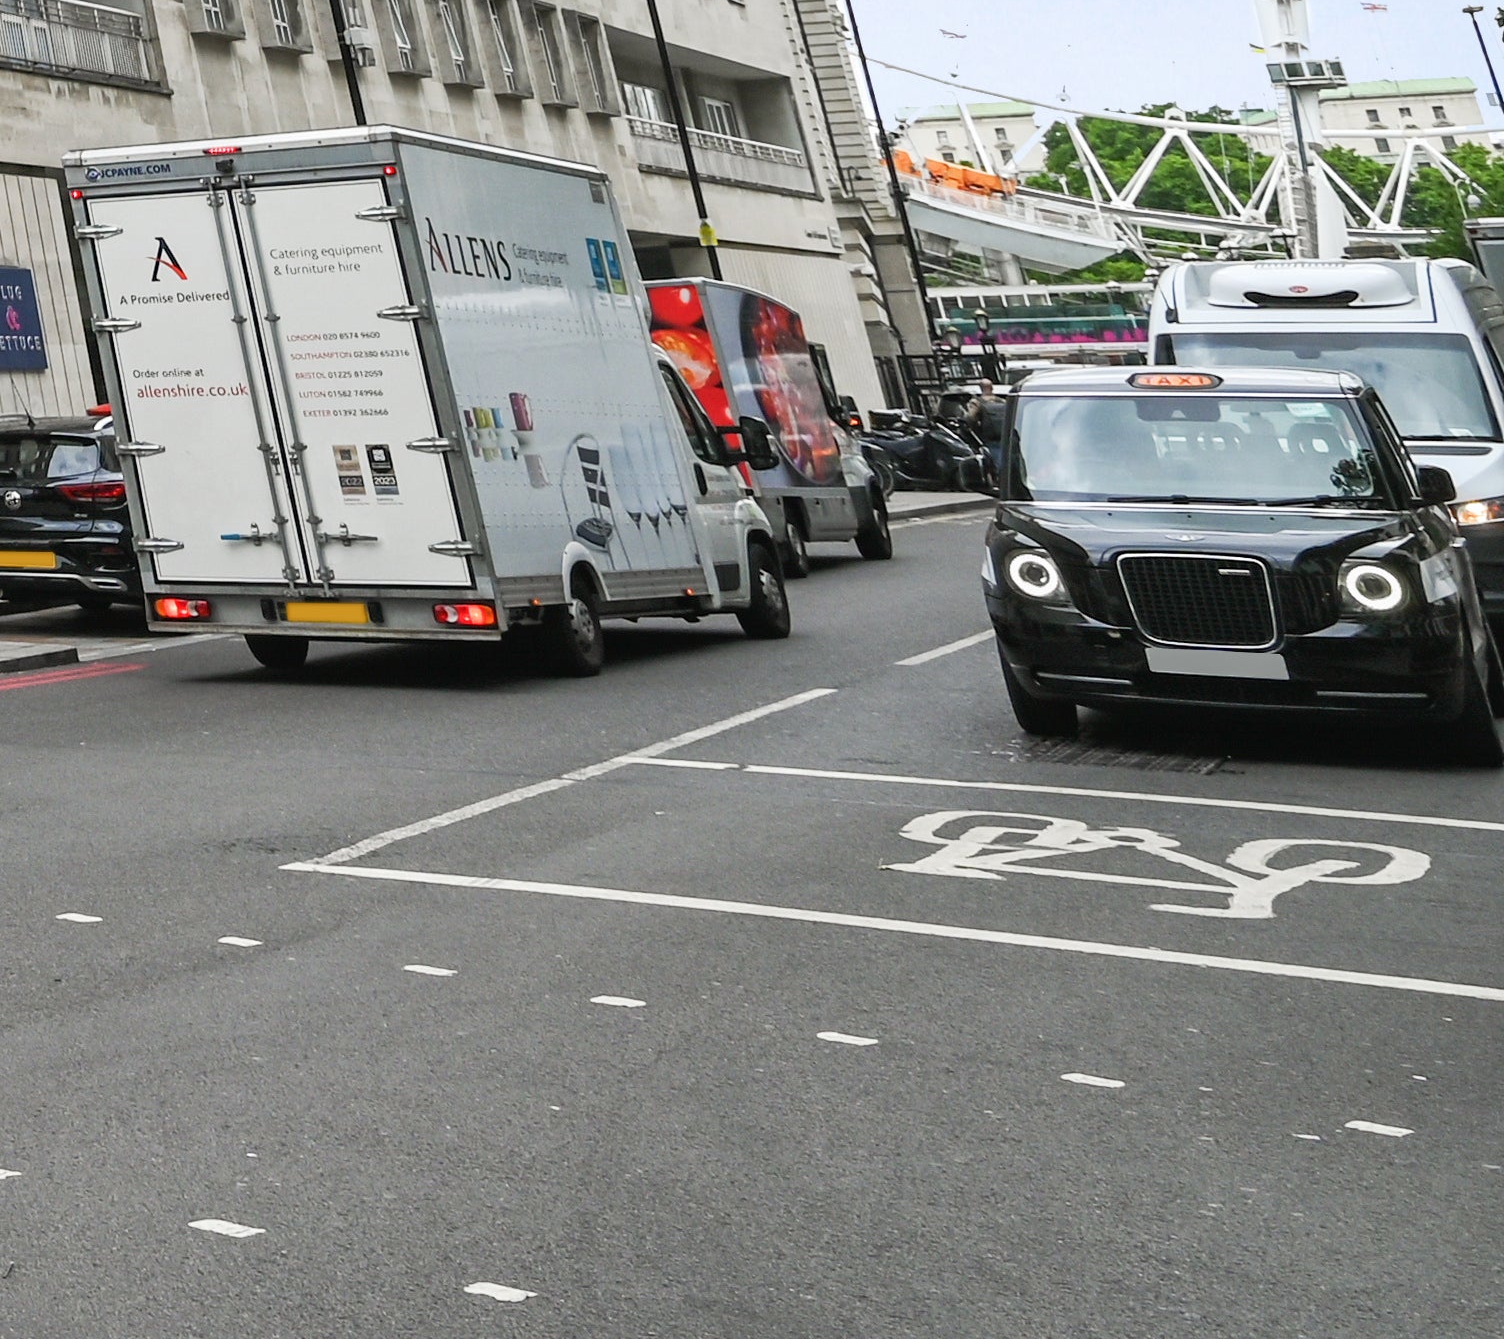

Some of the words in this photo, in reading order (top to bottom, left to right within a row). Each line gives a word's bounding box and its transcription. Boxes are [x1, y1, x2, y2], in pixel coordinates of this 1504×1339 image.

[269, 248, 319, 260] Catering
[321, 243, 383, 258] equipment
[424, 216, 512, 282] ALLENS
[273, 265, 282, 275] &
[286, 262, 335, 276] furniture
[338, 261, 361, 272] hire
[120, 295, 128, 305] A
[131, 292, 173, 305] Promise
[176, 290, 230, 303] Delivered
[287, 334, 321, 342] LONDON
[290, 352, 352, 360] SOUTHAMPTON
[132, 368, 159, 378] Order
[161, 368, 192, 378] online
[194, 368, 204, 377] at
[295, 371, 327, 379] BRISTOL
[1141, 375, 1205, 386] TAXI
[137, 383, 249, 399] allenshire.co.uk
[299, 390, 326, 398] LUTON
